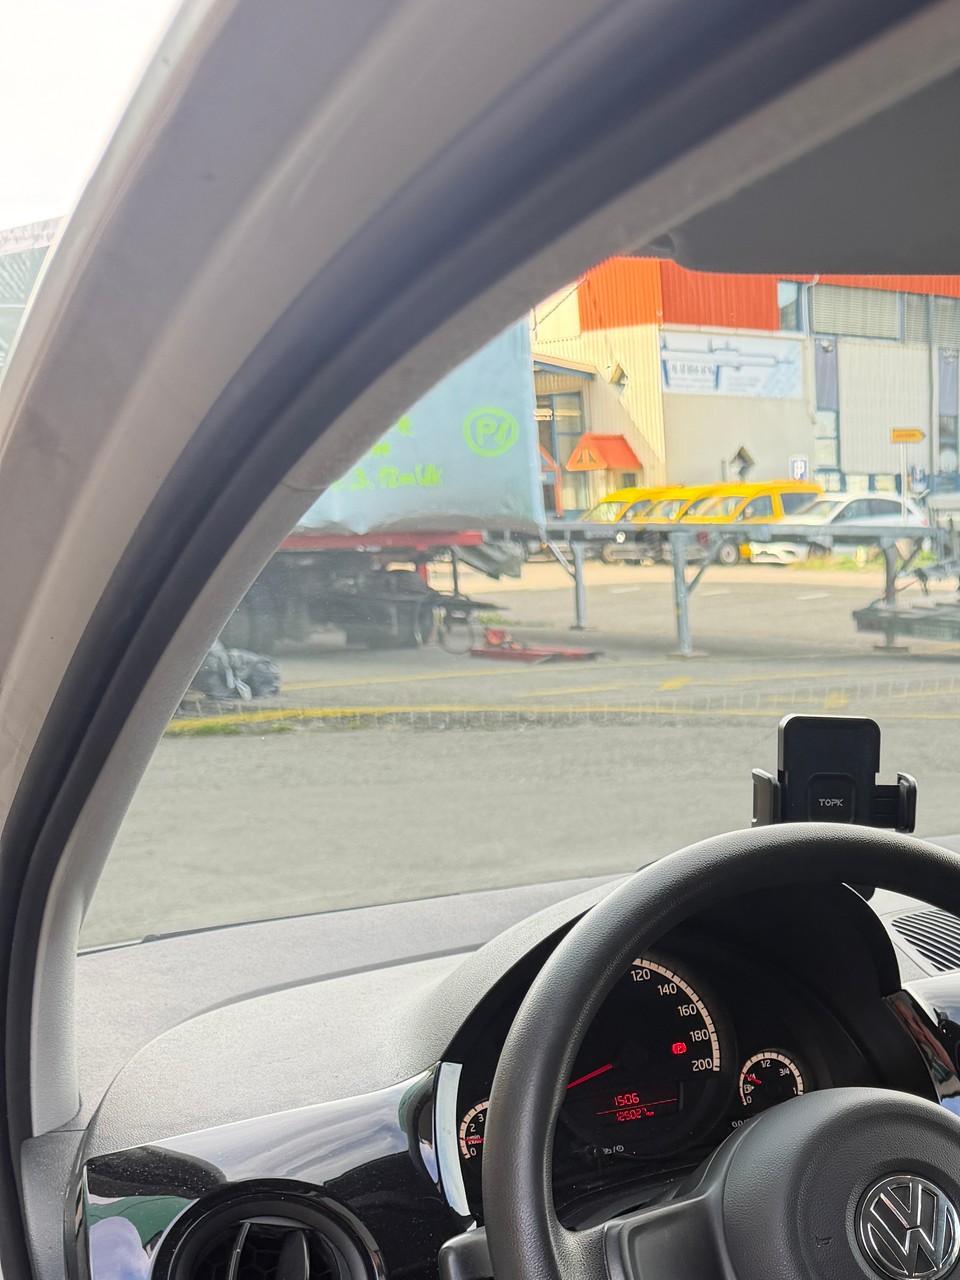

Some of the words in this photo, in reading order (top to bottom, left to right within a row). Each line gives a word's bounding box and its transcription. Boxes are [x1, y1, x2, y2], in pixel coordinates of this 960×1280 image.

[818, 798, 844, 807] TOPK
[631, 968, 651, 982] 120
[657, 982, 677, 996] 140
[677, 1003, 697, 1017] 160
[689, 1029, 709, 1042] 180
[691, 1058, 713, 1072] 200
[760, 1059, 771, 1068] 1/2
[779, 1067, 790, 1077] 3/4
[614, 1092, 640, 1106] 1506
[746, 1096, 752, 1104] 0
[477, 1113, 484, 1122] 3
[469, 1123, 476, 1132] 2
[470, 1147, 477, 1156] 0
